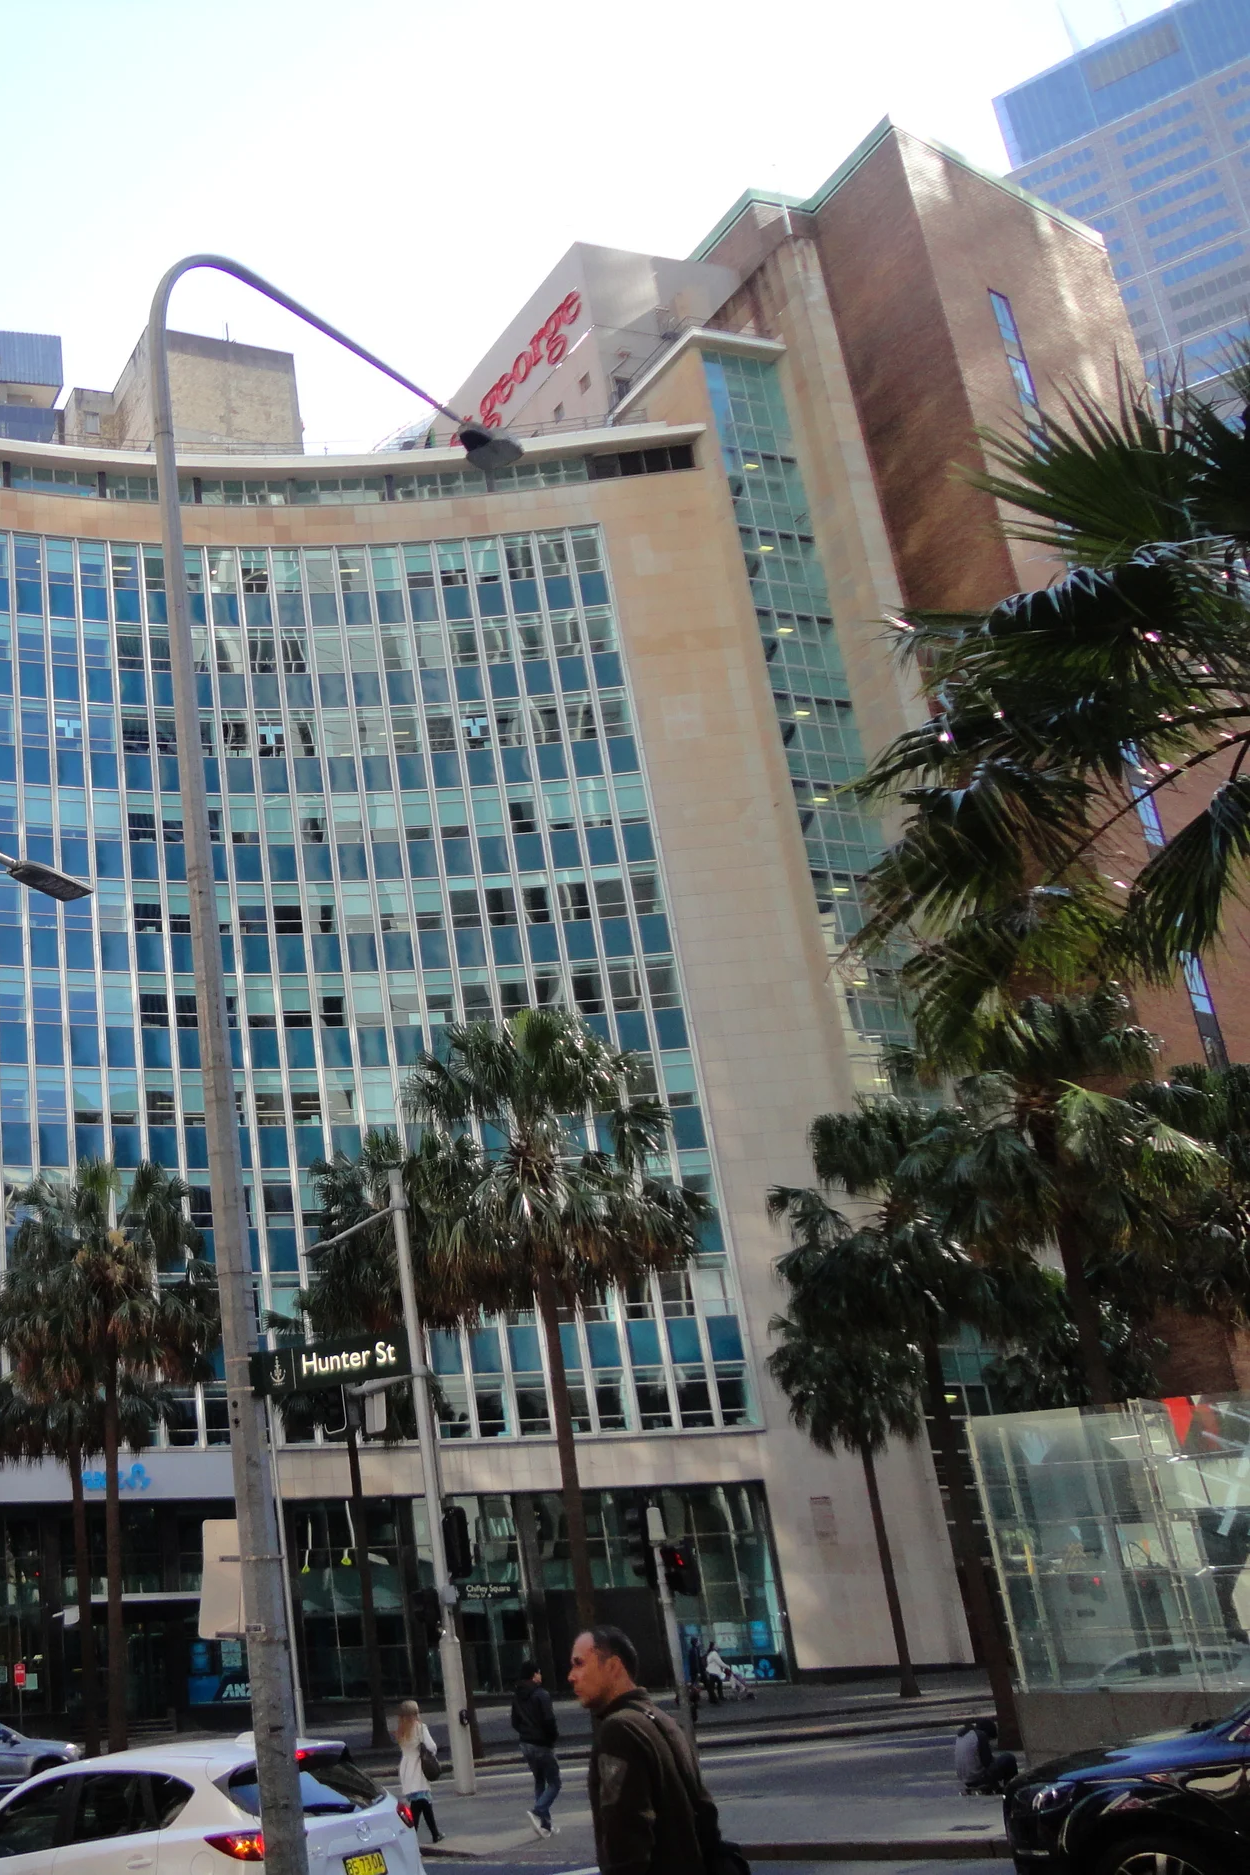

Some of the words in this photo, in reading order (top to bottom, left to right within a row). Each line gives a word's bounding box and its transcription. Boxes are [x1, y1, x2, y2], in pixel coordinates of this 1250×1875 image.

[479, 290, 582, 429] george
[301, 1349, 370, 1376] Hunter
[375, 1341, 396, 1363] St
